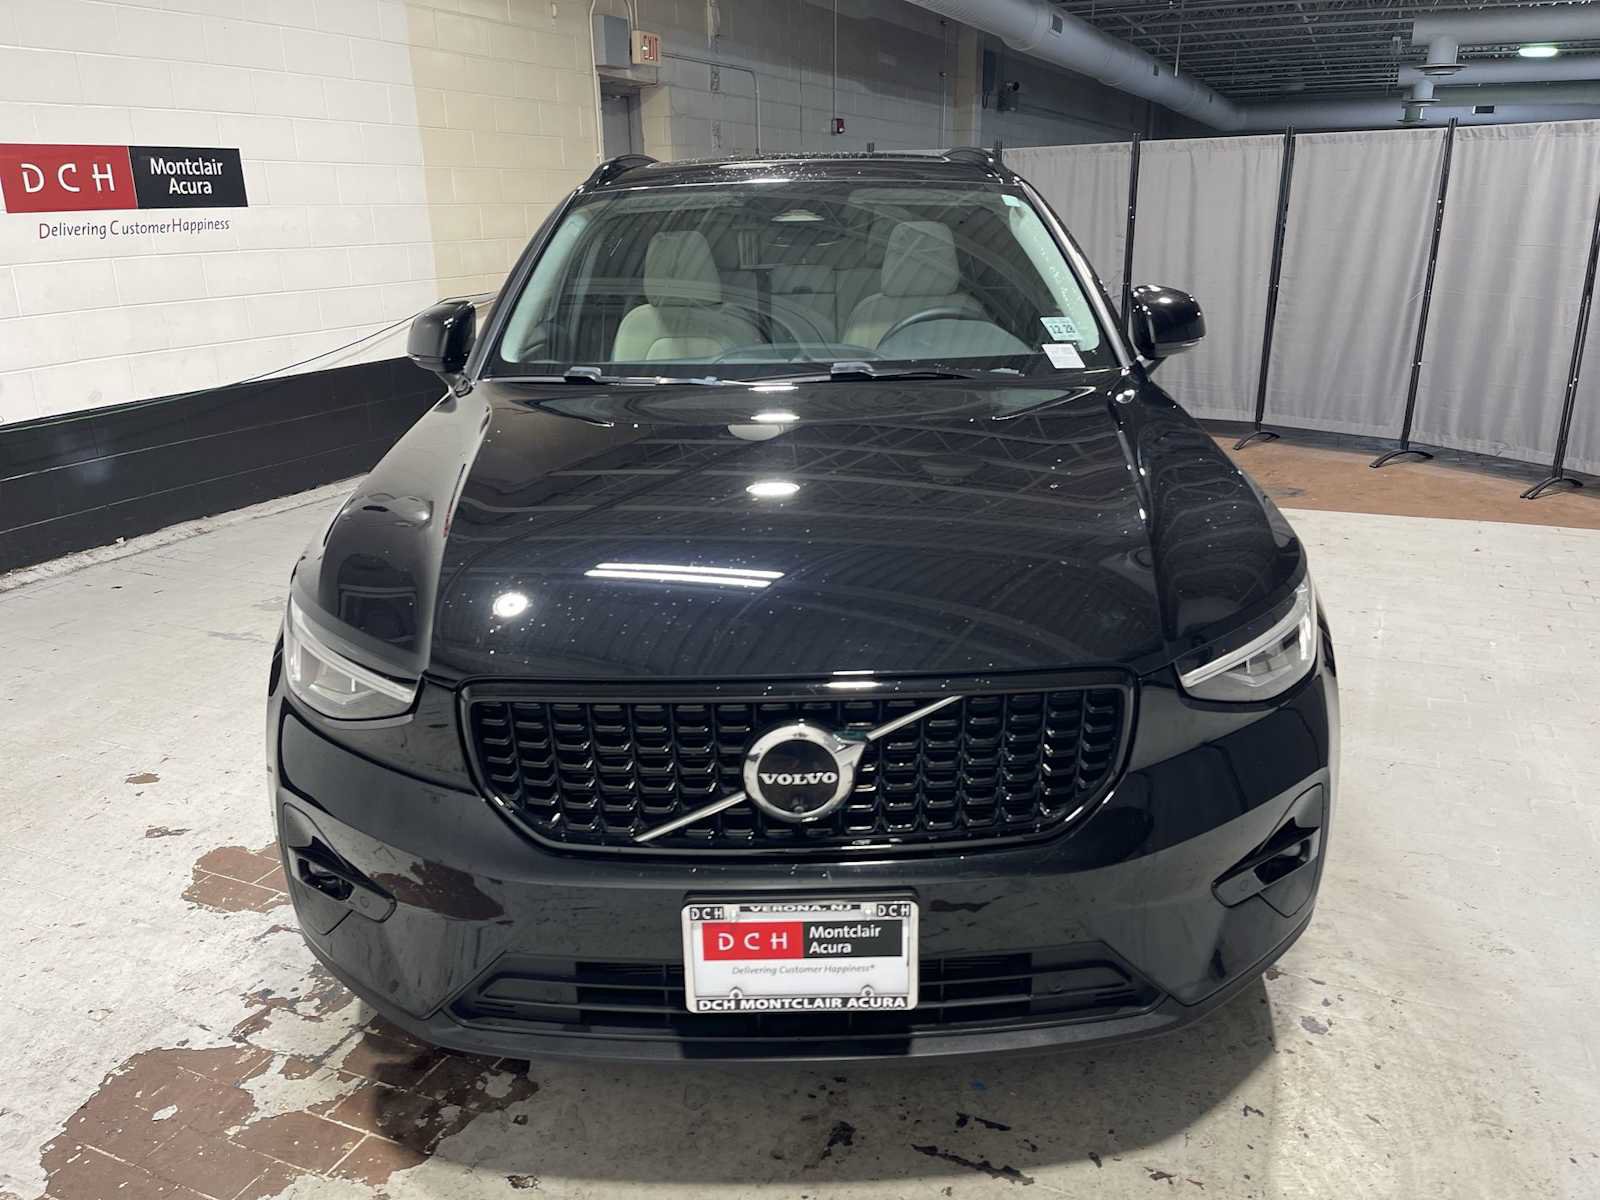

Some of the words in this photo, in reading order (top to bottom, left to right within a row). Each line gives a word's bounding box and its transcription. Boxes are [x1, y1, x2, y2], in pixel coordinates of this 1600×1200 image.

[150, 157, 224, 176] Montclair
[168, 178, 213, 195] Acura
[39, 221, 107, 239] Delivering
[759, 772, 838, 785] VOLVO
[809, 924, 882, 939] Montclair
[809, 941, 852, 955] Acura
[731, 966, 777, 976] Delivering
[778, 965, 822, 975] Customer
[699, 999, 735, 1012] DCH
[740, 997, 843, 1010] MONTCLAIR
[847, 995, 906, 1009] ACURA
